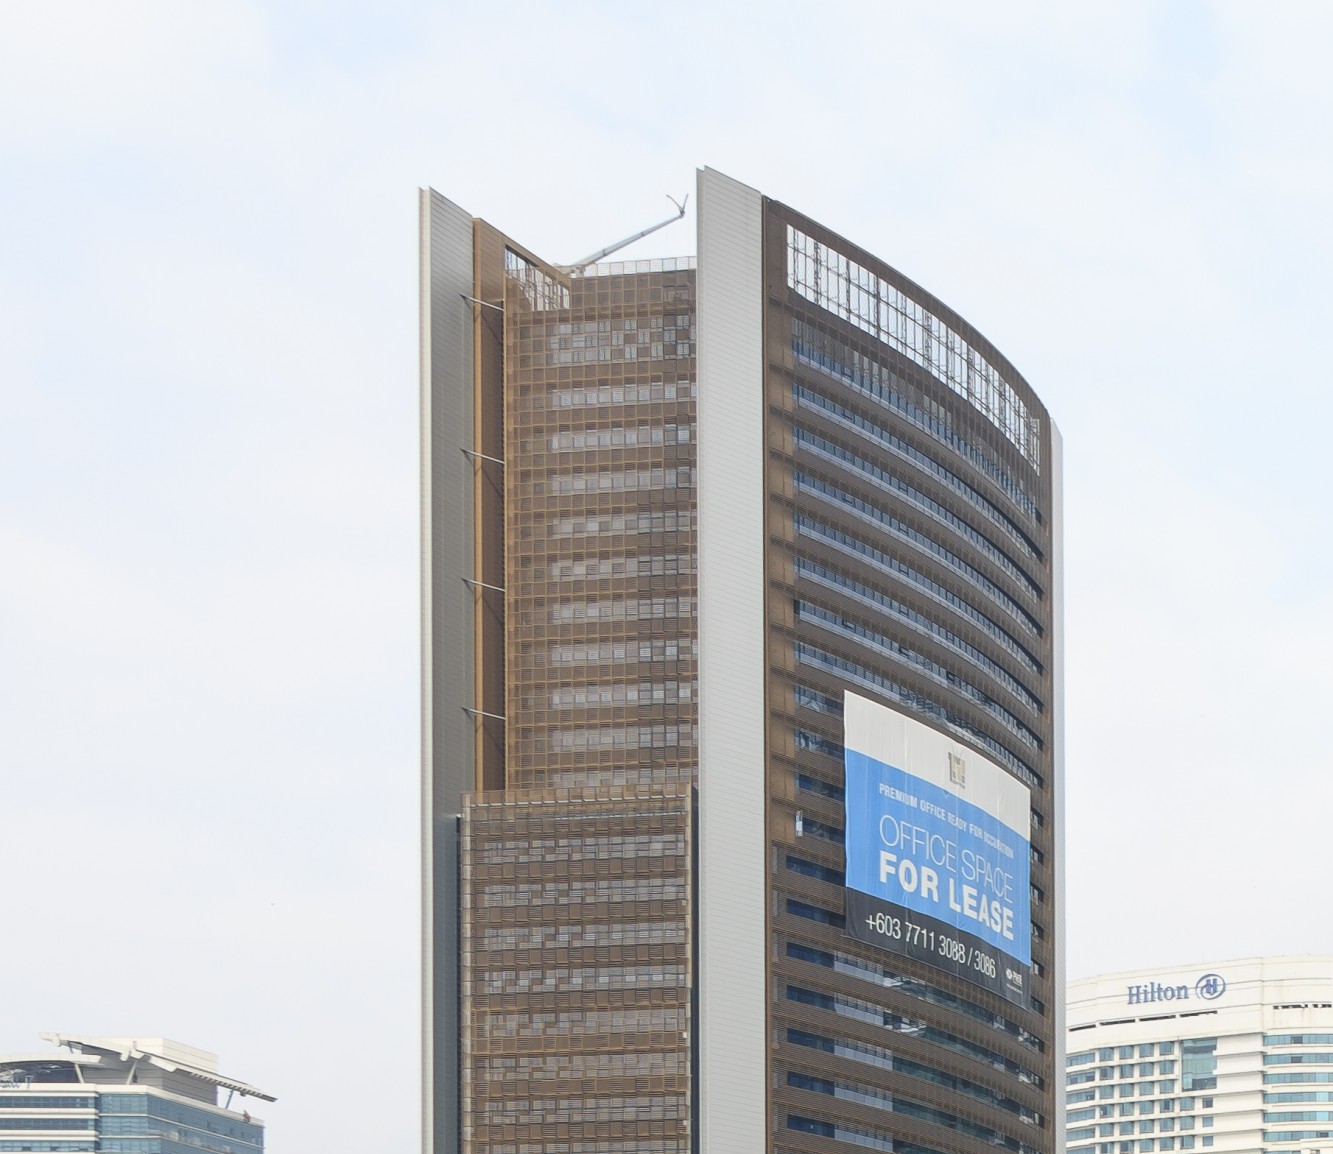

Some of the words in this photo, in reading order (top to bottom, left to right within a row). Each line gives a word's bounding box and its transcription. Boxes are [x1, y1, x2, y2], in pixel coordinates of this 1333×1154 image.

[879, 783, 917, 808] PREMIUM
[920, 800, 946, 821] OFFICE
[969, 823, 983, 839] FOR
[879, 814, 957, 873] OFFICE
[961, 849, 1013, 904] SPACE
[879, 850, 940, 902] FOR
[949, 877, 1014, 941] LEASE
[865, 912, 901, 939] +603
[905, 921, 935, 951] 7711
[938, 935, 966, 964] 3088
[974, 950, 996, 978] 3086
[1127, 981, 1190, 1005] Hilton
